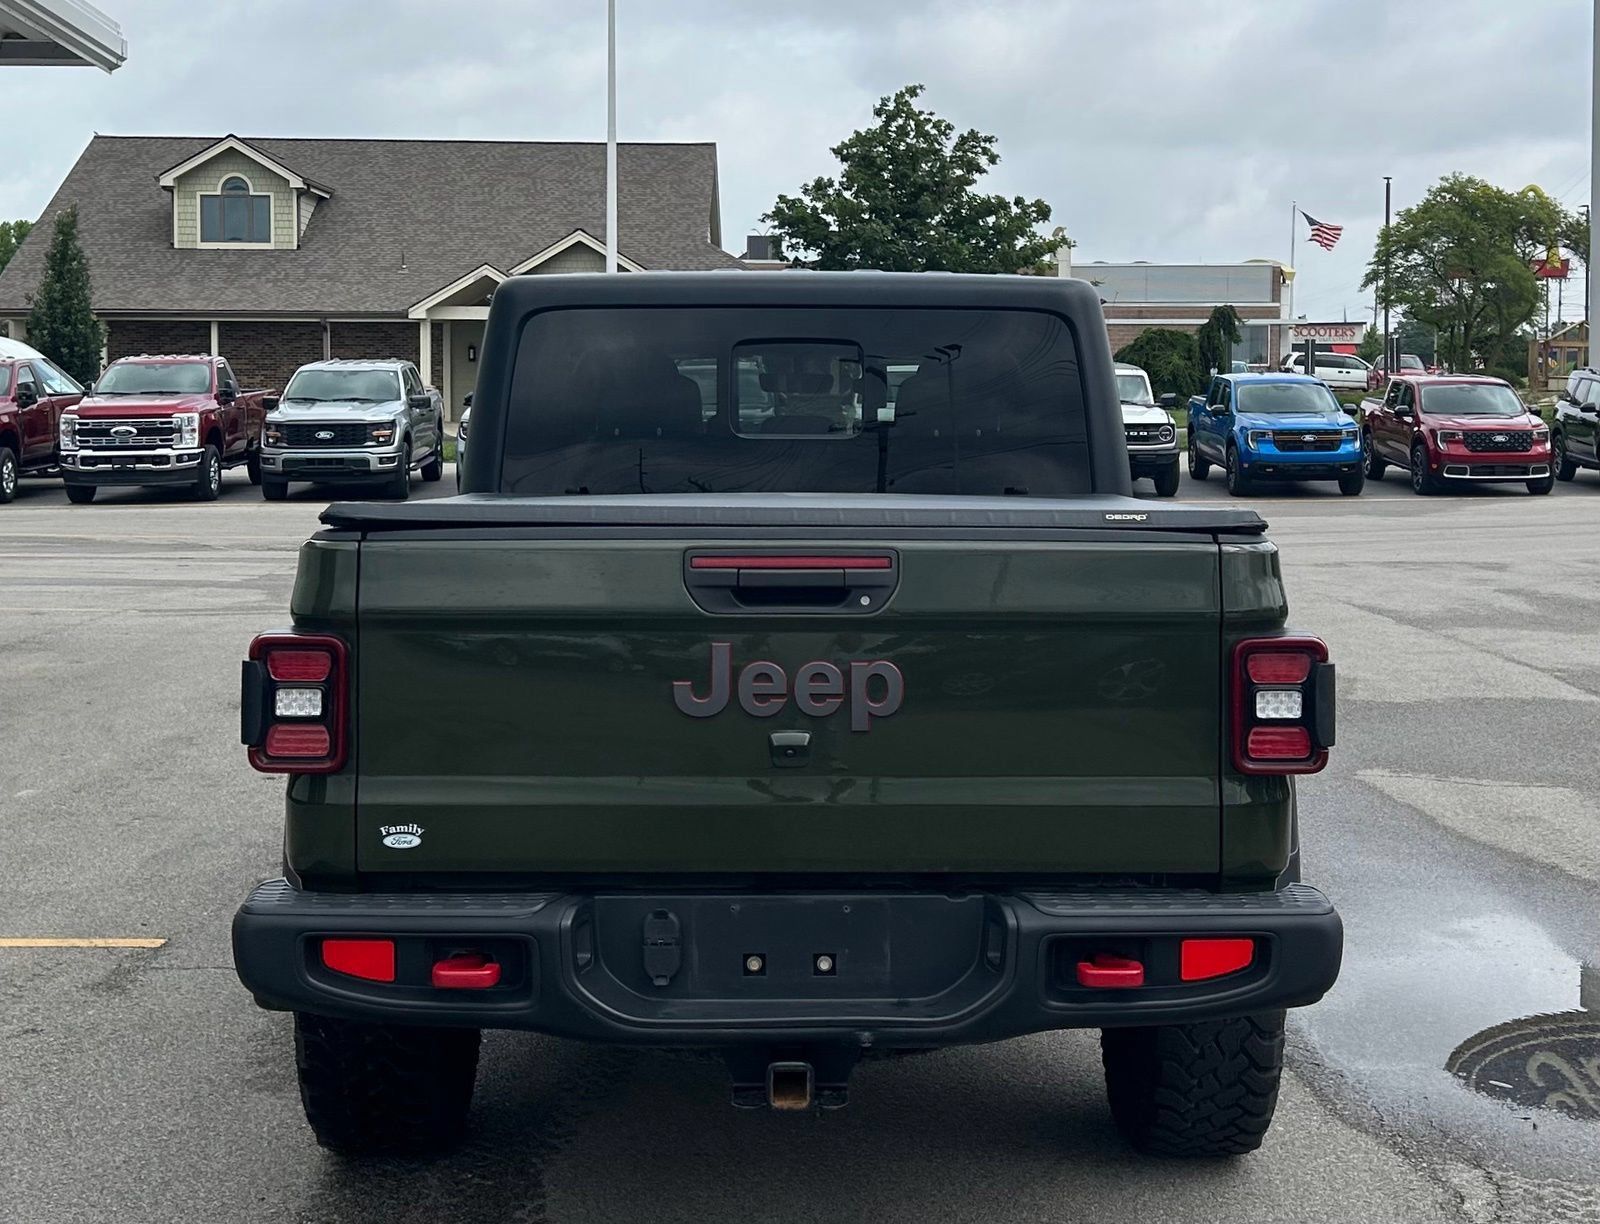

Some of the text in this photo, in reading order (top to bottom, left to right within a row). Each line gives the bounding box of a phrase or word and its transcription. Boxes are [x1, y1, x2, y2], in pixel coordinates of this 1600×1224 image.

[673, 642, 904, 732] Jeep
[380, 823, 425, 836] Family
[390, 836, 414, 846] Ford
